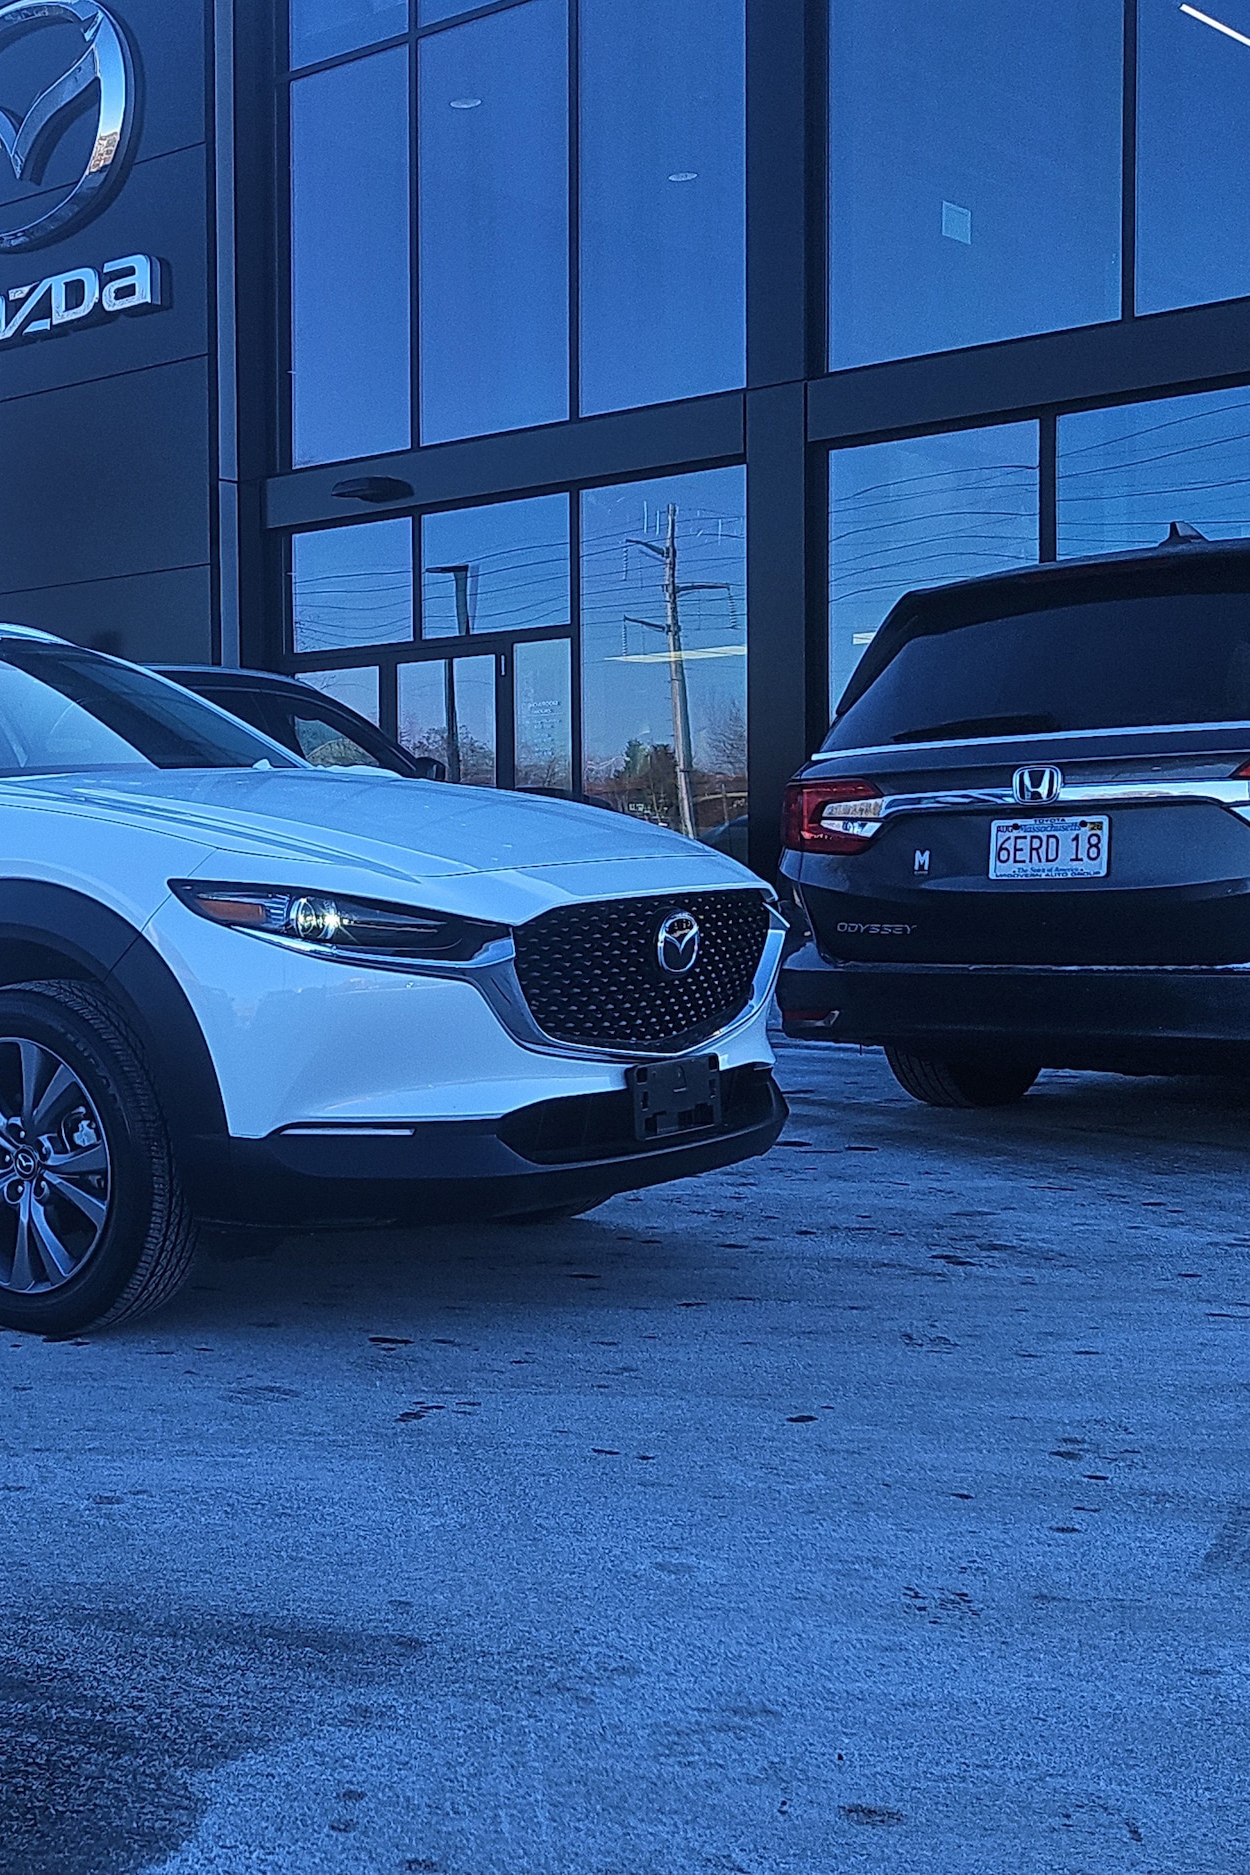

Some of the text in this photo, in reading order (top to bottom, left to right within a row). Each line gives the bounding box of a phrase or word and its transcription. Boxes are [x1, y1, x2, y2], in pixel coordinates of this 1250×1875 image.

[1019, 822, 1082, 833] Massachusetts
[997, 833, 1102, 864] 6ERD 18
[914, 850, 930, 871] M
[837, 922, 917, 935] ODYSSEY
